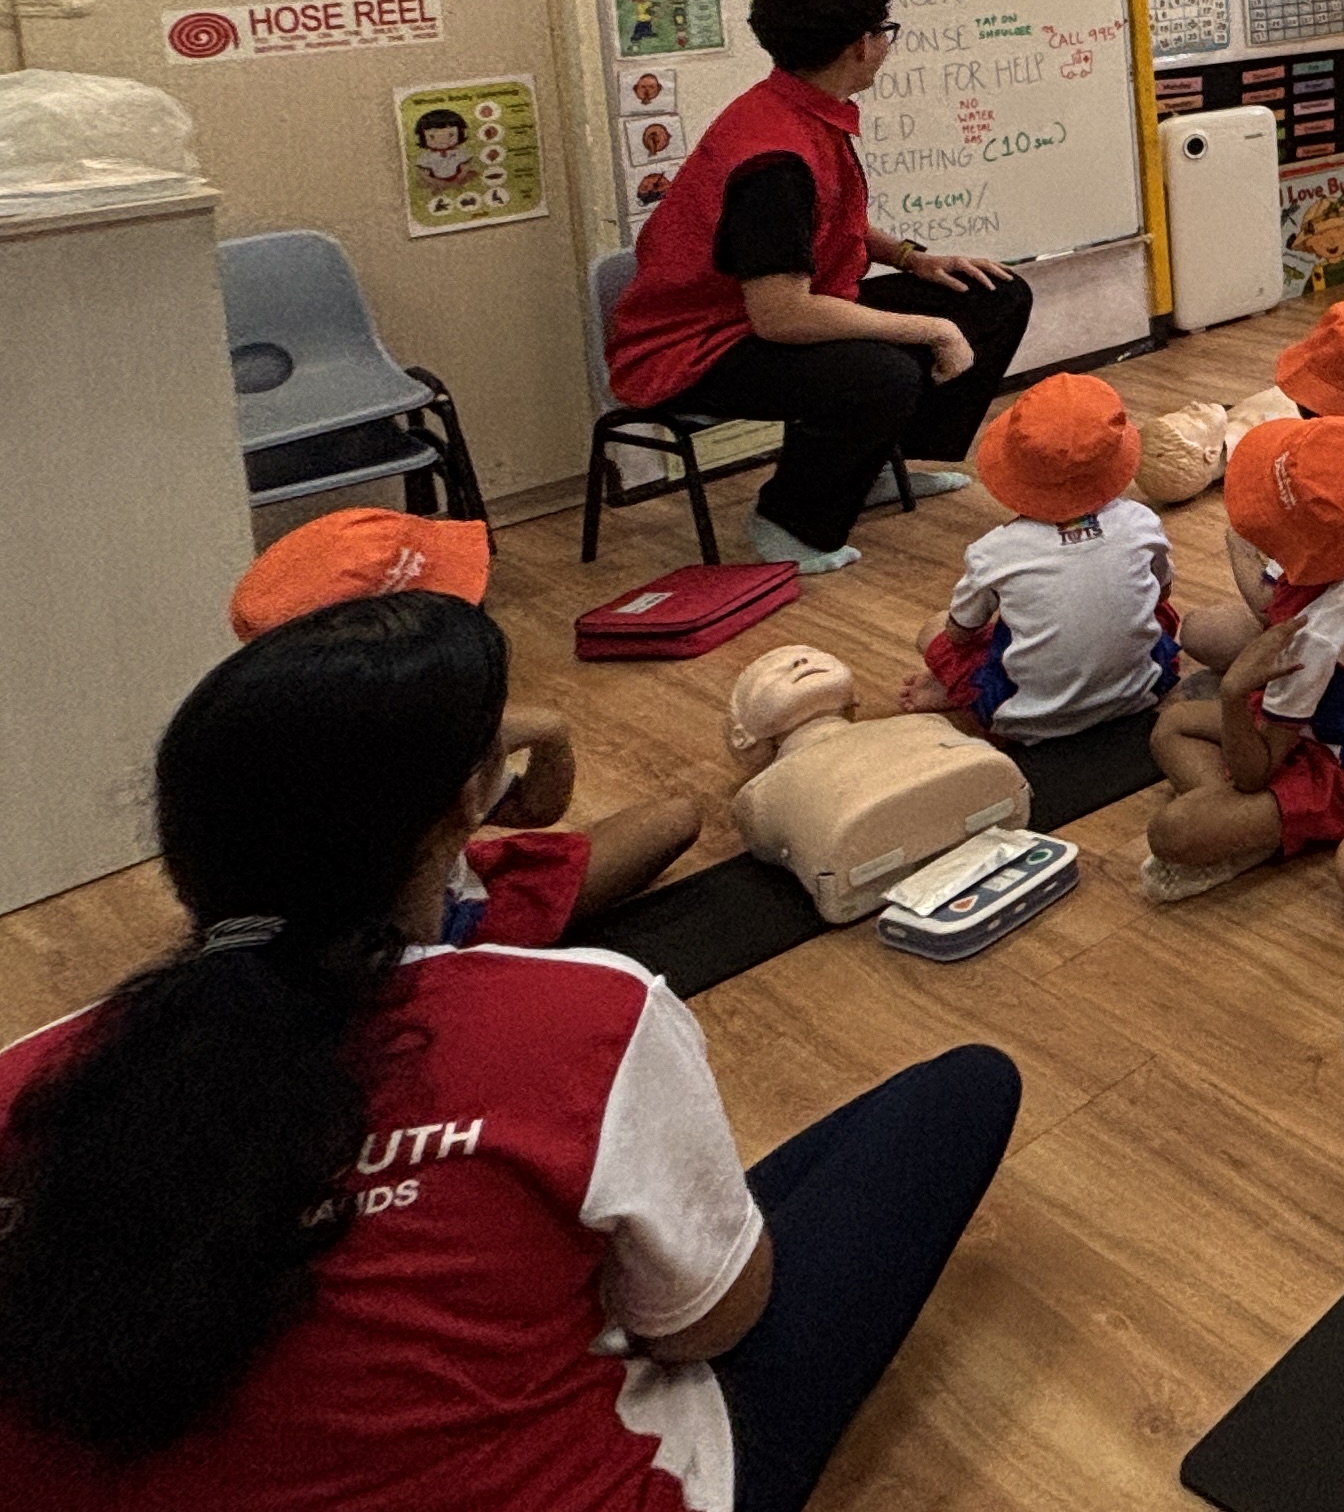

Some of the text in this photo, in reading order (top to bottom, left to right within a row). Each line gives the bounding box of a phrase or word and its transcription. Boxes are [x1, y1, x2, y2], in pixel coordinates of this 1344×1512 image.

[249, 2, 346, 36] HOSE
[974, 12, 1018, 28] TAP ON
[890, 24, 972, 55] PONSE
[858, 51, 1045, 102] HOUT FOR HELP
[957, 110, 996, 123] WATER
[959, 98, 979, 110] NO
[962, 123, 992, 134] METAL
[865, 145, 974, 178] REATHING
[1287, 184, 1324, 205] Love
[356, 1117, 485, 1176] UTH
